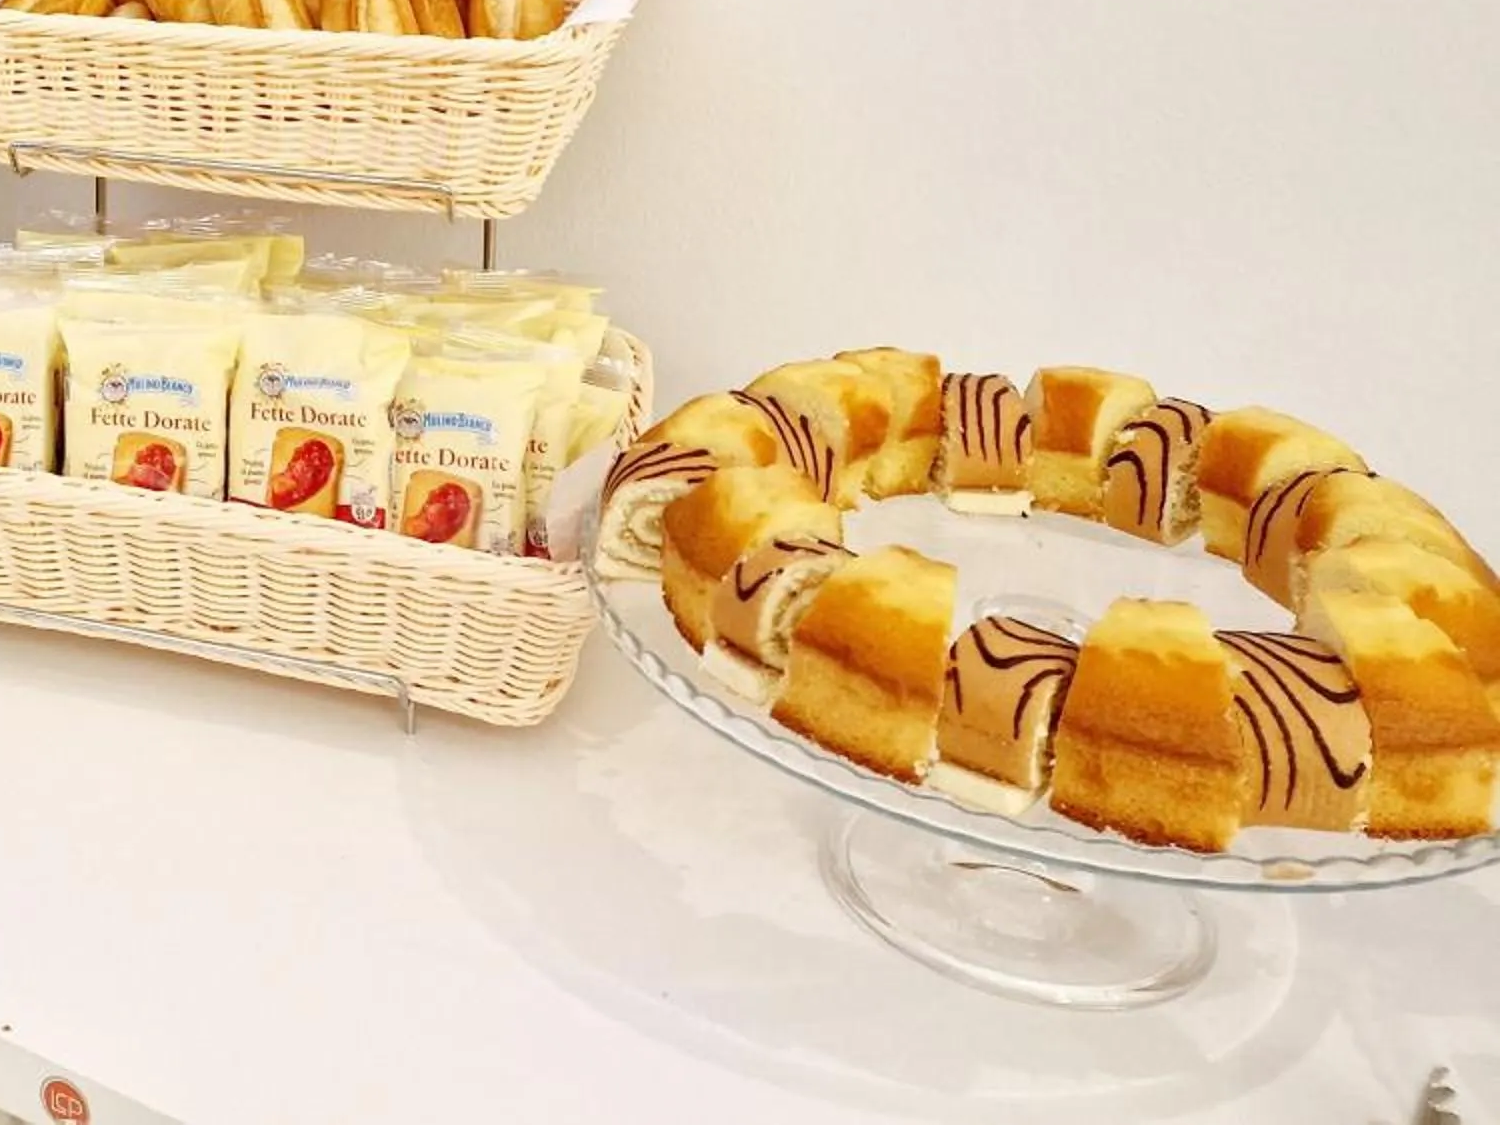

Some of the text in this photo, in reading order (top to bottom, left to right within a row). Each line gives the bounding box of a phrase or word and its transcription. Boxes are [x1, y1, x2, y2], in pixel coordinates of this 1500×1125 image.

[90, 407, 212, 432] Fette Dorate
[250, 402, 367, 427] Fette Dorate
[394, 447, 431, 465] ette
[438, 447, 511, 472] Dorate
